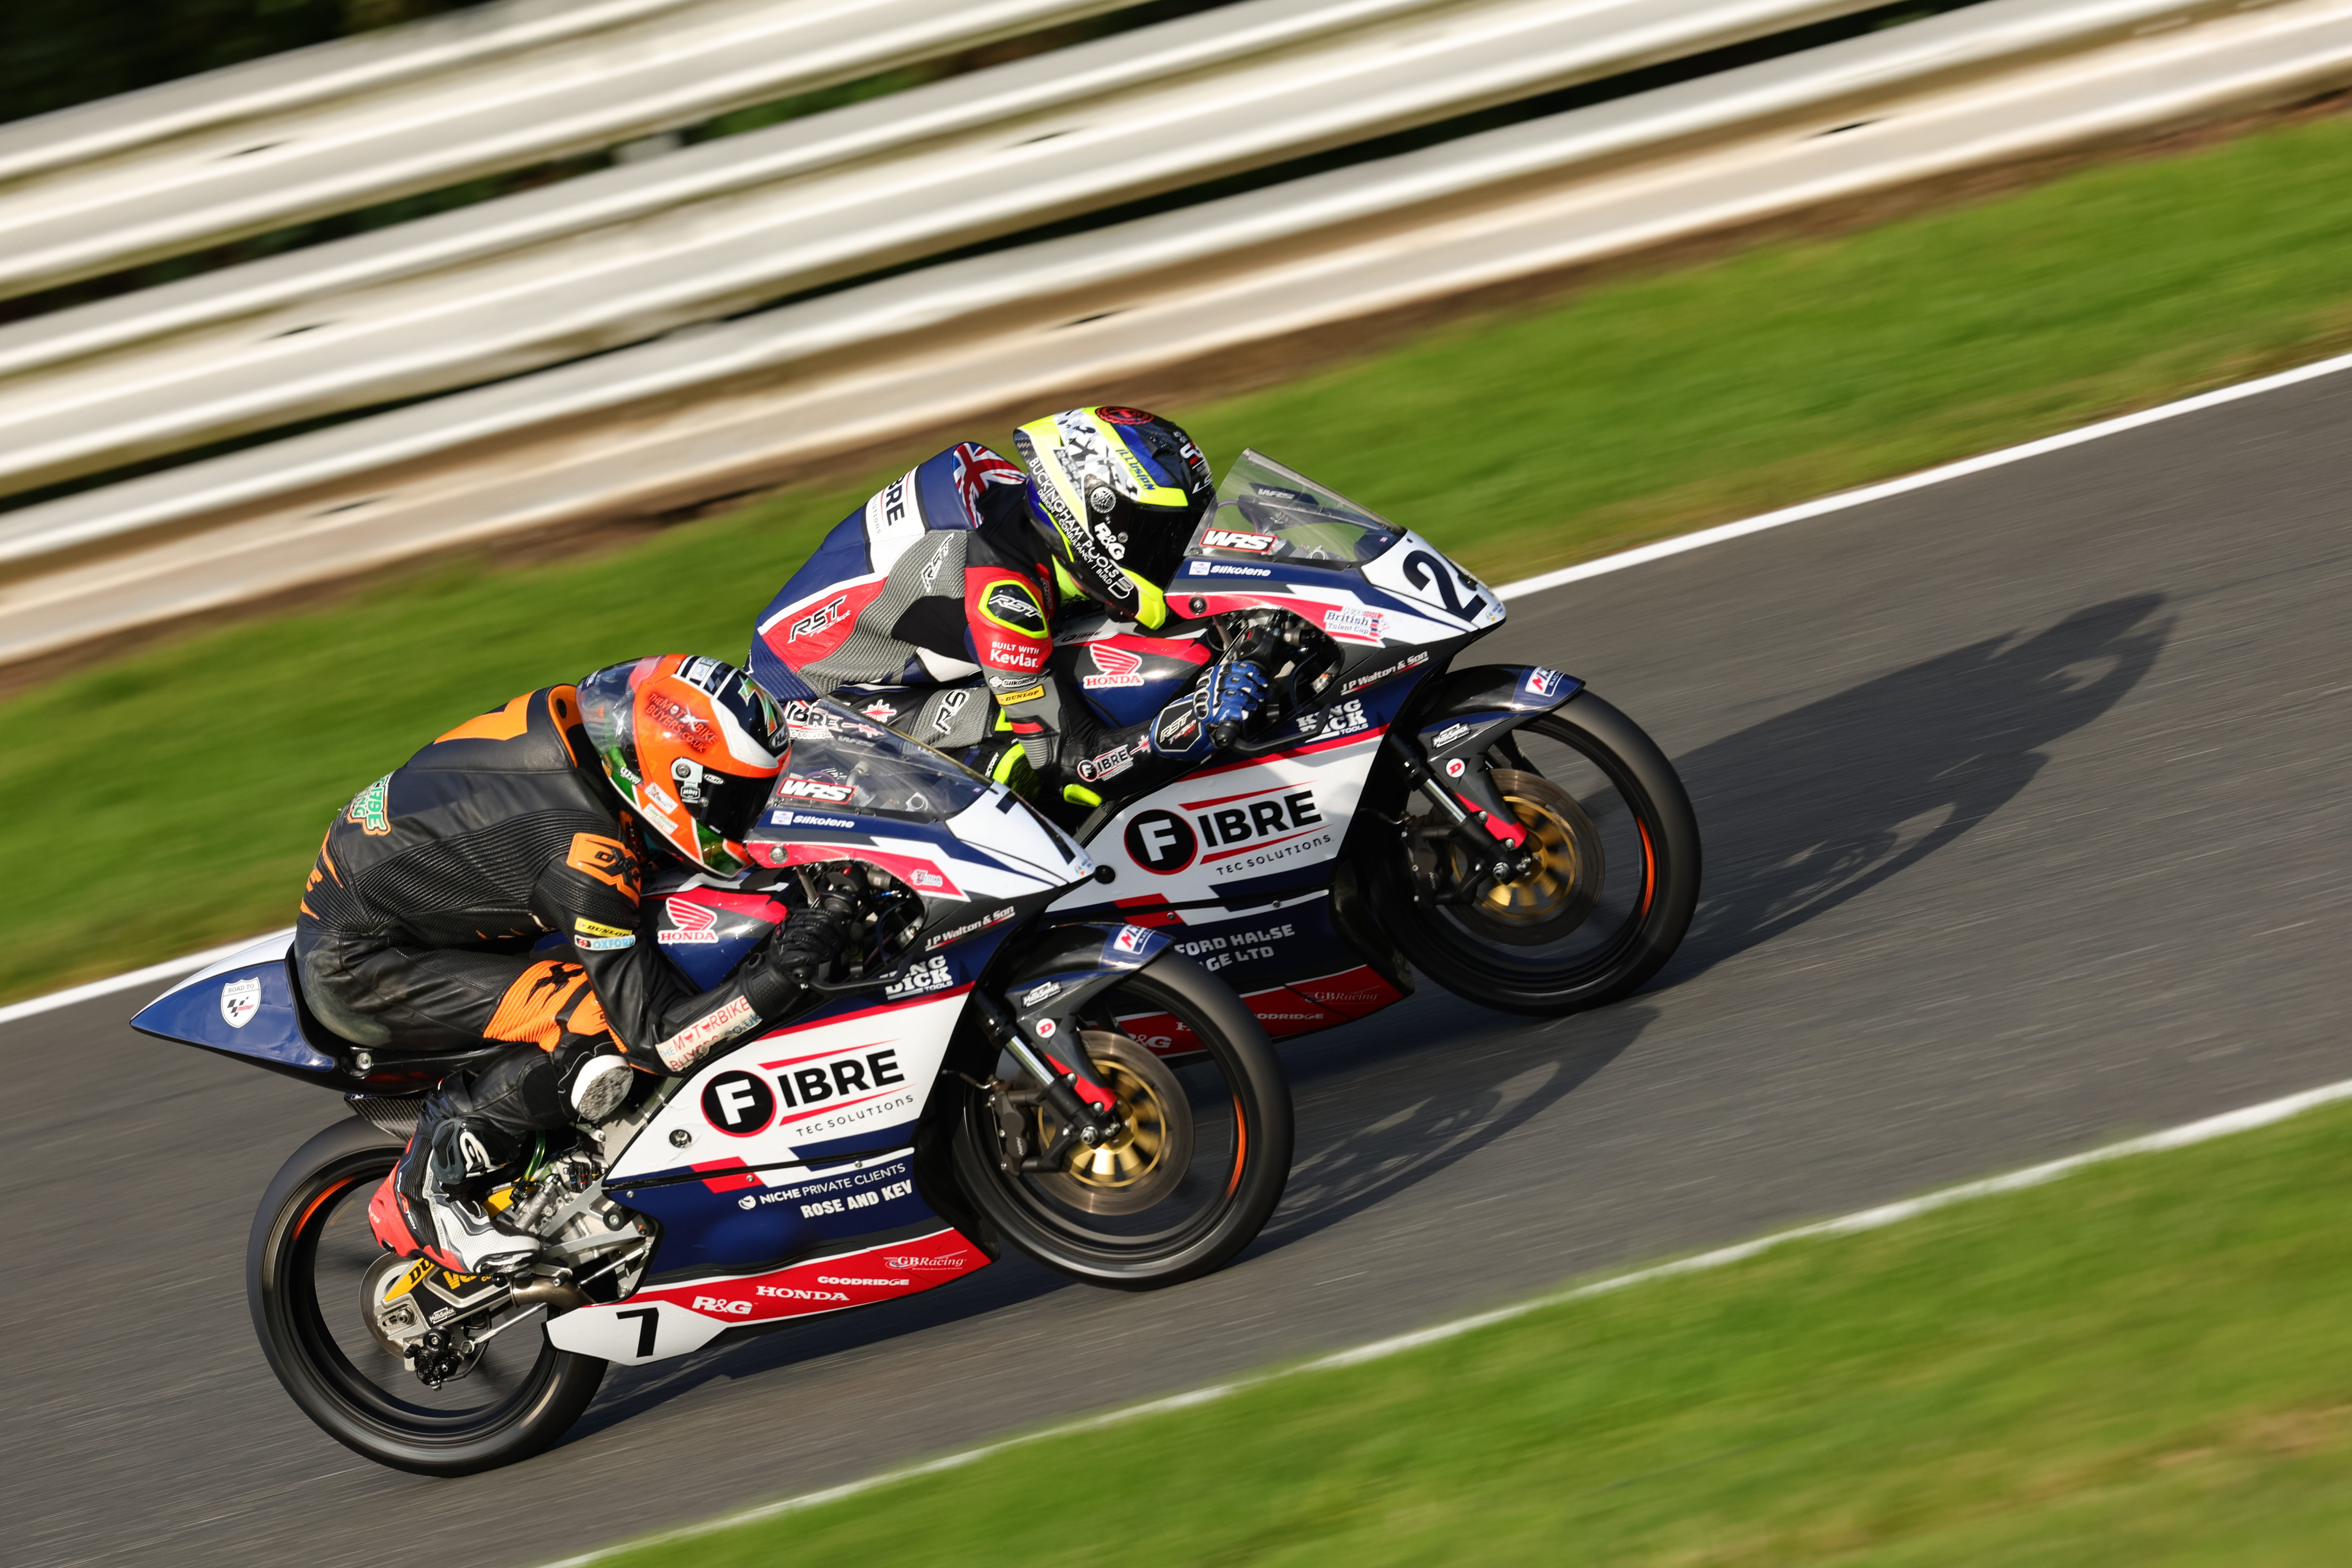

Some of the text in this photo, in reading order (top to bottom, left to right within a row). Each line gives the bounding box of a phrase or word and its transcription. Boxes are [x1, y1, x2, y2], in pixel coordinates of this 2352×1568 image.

[1029, 457, 1084, 540] BUCKINGHAM
[1037, 488, 1055, 513] DESIGN
[1058, 519, 1094, 563] CONSULTANCY
[1096, 568, 1112, 584] BUILD
[1094, 522, 1125, 561] R&G
[1202, 530, 1274, 550] WRS
[1210, 565, 1271, 577] Silkolene
[988, 594, 1043, 619] RST
[788, 594, 848, 644] RST
[1327, 612, 1368, 625] British
[992, 641, 1040, 655] BUILT WITH
[1341, 651, 1428, 693] J P Walton & Son
[1003, 677, 1036, 686] Silkolene
[1085, 675, 1142, 686] HONDA
[649, 693, 664, 705] THE
[1005, 690, 1039, 702] DUNLOP
[932, 689, 971, 735] RS
[1296, 699, 1361, 728] KNG
[1160, 709, 1192, 743] RST
[1340, 722, 1369, 735] TOOLS
[1450, 762, 1461, 775] D
[781, 780, 852, 801] WRS
[648, 806, 660, 819] Valley
[793, 815, 855, 828] Silkolene
[1139, 790, 1323, 861] FIBRE
[1217, 862, 1243, 875] TEC
[925, 906, 1014, 949] J P Walton & Son
[1230, 924, 1295, 946] HALSE
[593, 937, 634, 949] OXFORD
[661, 932, 716, 942] HONDA
[1199, 946, 1274, 972] GE LTD
[924, 981, 953, 992] TOOLS
[1315, 992, 1377, 1000] GBRacing
[1040, 1023, 1052, 1035] D
[659, 1046, 676, 1058] THE
[715, 1049, 905, 1125] FIBRE
[796, 1122, 823, 1137] TEC
[759, 1162, 906, 1205] NICHE PRIVATE CLIENTS
[800, 1179, 913, 1218] ROSE AND KEV
[897, 1256, 964, 1267] GBRacing
[817, 1276, 909, 1286] GOODRIDGE
[756, 1285, 849, 1301] HONDA
[691, 1296, 753, 1314] R&G
[616, 1307, 659, 1357] 7
